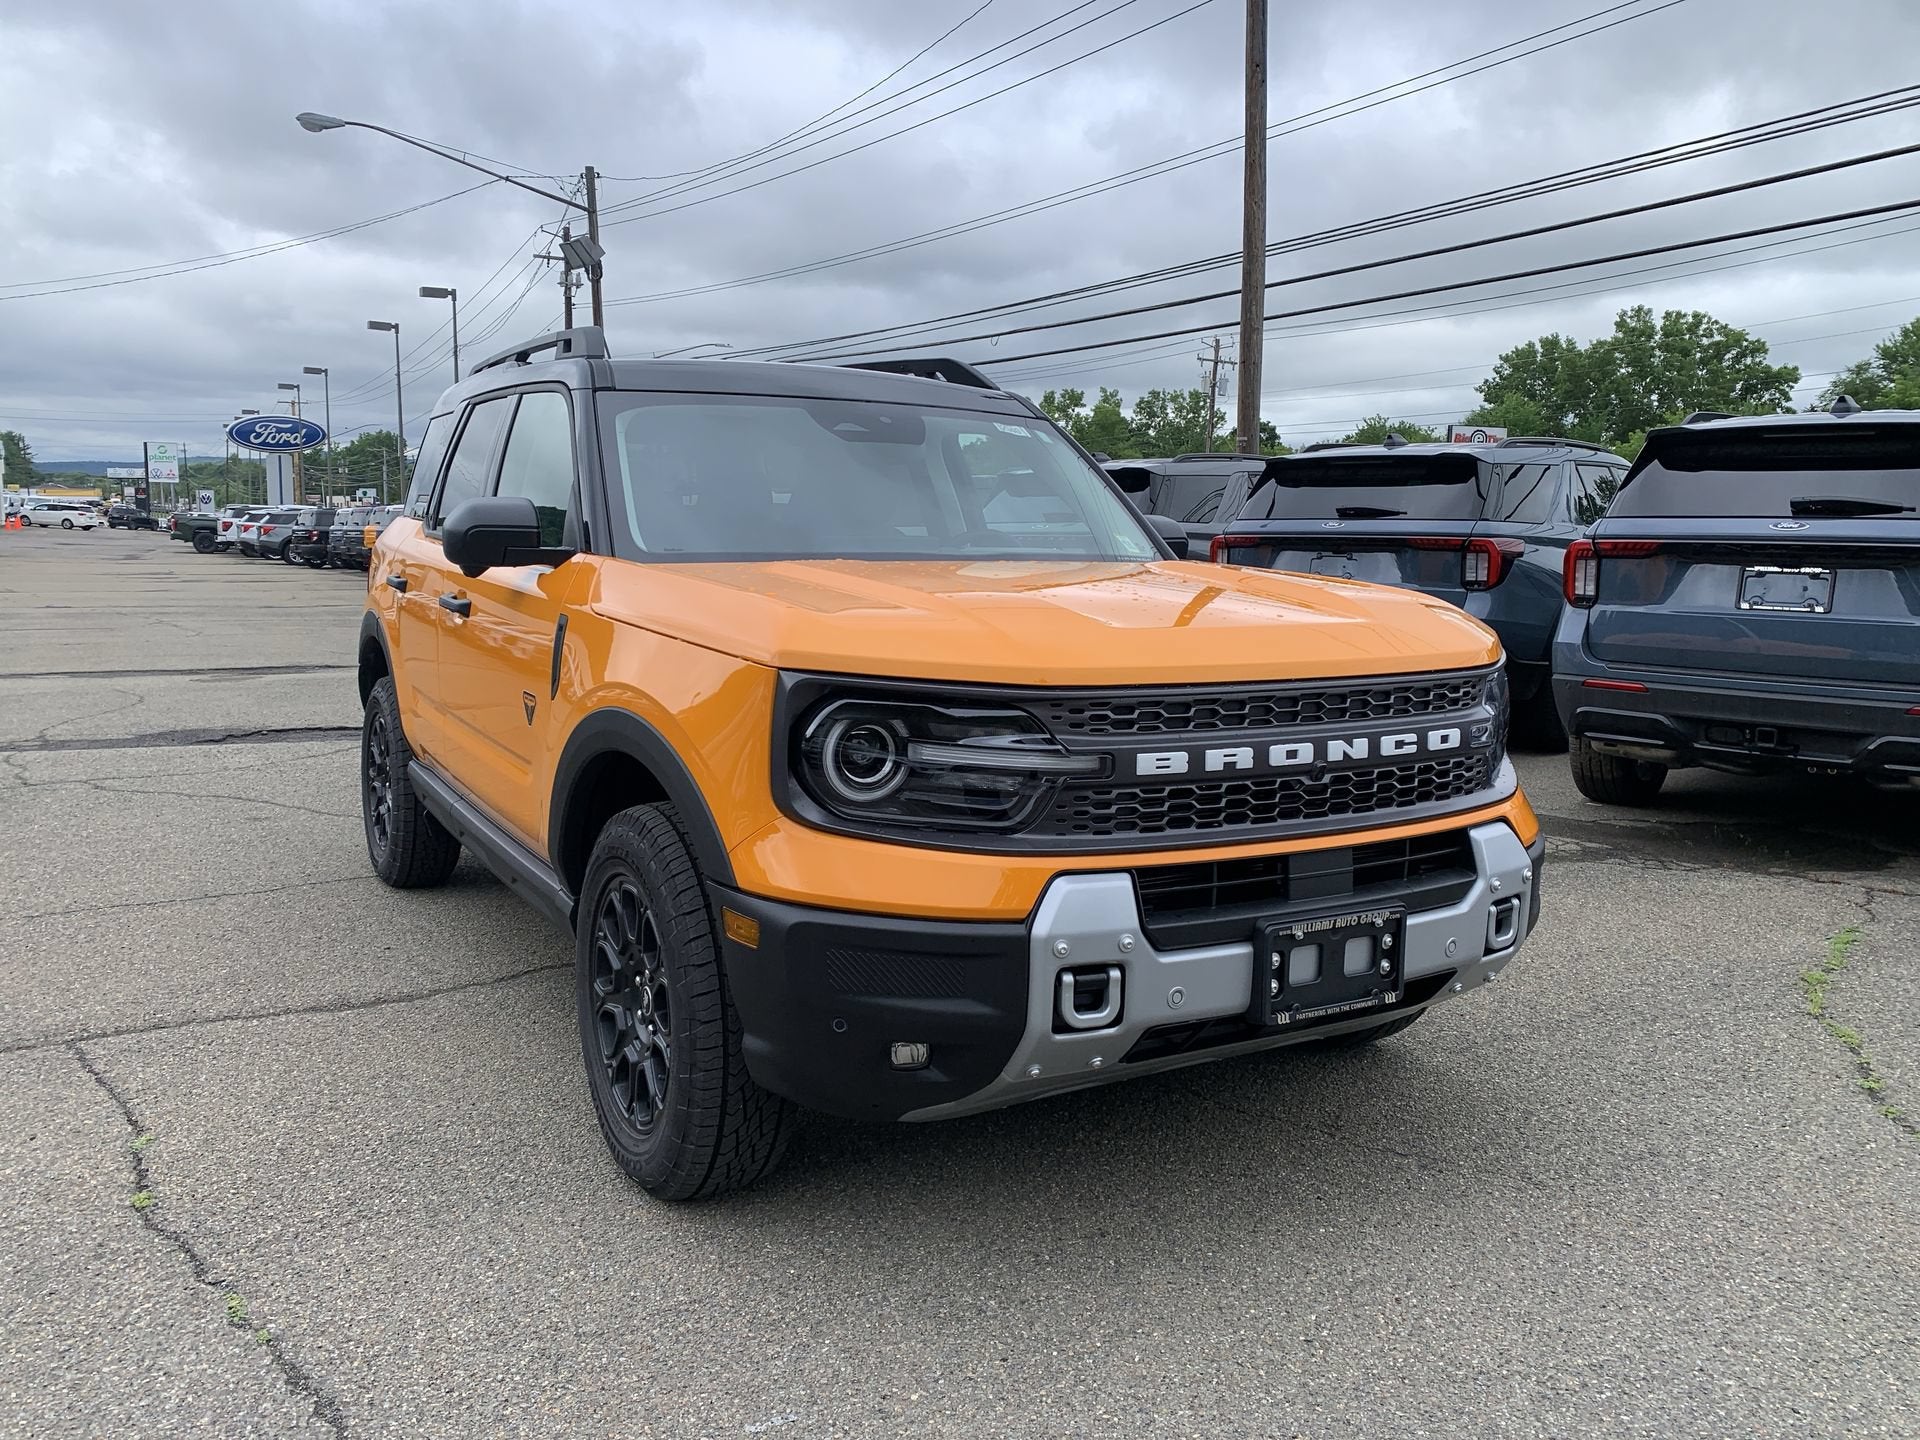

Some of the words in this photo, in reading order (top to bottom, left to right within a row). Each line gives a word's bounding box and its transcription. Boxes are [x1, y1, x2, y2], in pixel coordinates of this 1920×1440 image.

[249, 422, 307, 444] Ford
[1136, 728, 1461, 775] BRONCO
[1335, 914, 1358, 928] AUTO
[1296, 1009, 1326, 1020] PARTNERING
[1327, 1006, 1340, 1015] WITH
[1341, 1003, 1350, 1011] THE
[1351, 1000, 1379, 1010] COMMUNITY
